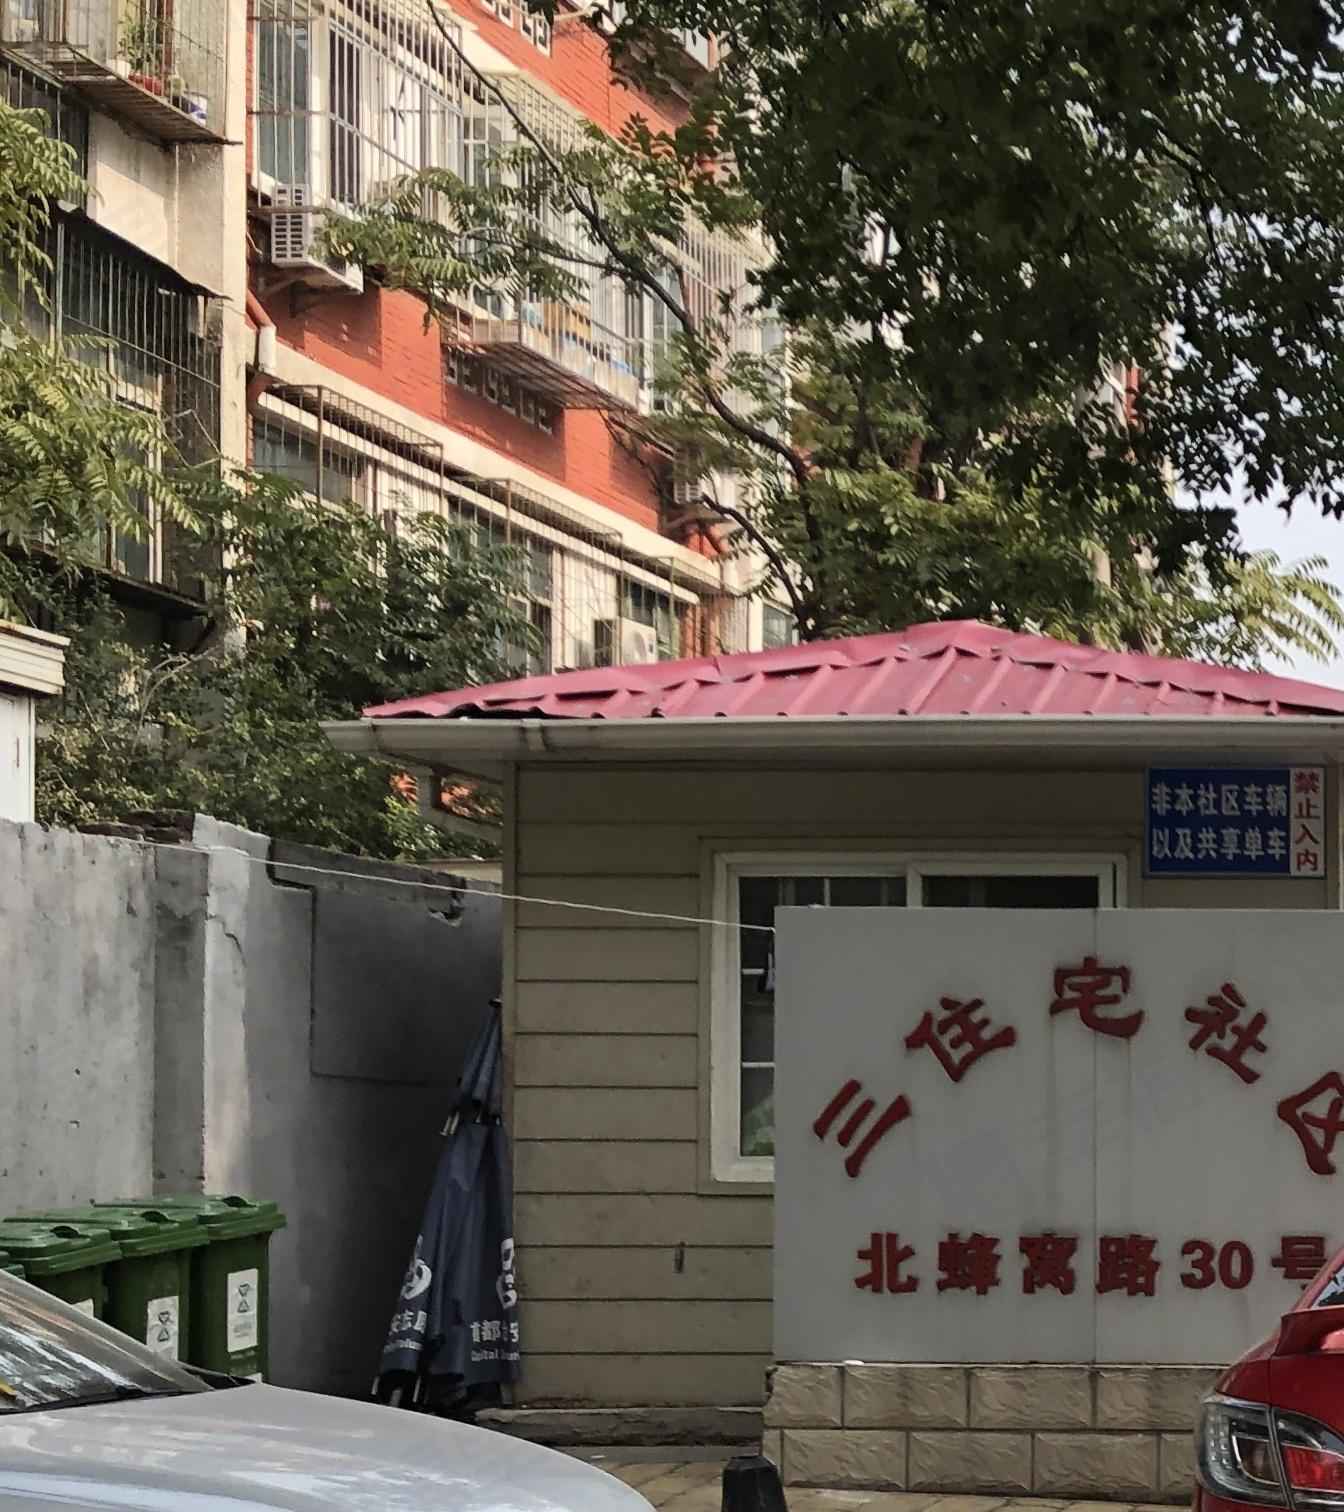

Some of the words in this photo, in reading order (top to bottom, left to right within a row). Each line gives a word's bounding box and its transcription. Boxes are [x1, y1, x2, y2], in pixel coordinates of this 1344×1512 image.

[1152, 782, 1287, 816] 非本社区车辆
[1294, 770, 1320, 872] 禁止入内
[1152, 826, 1287, 860] 以及共享单车
